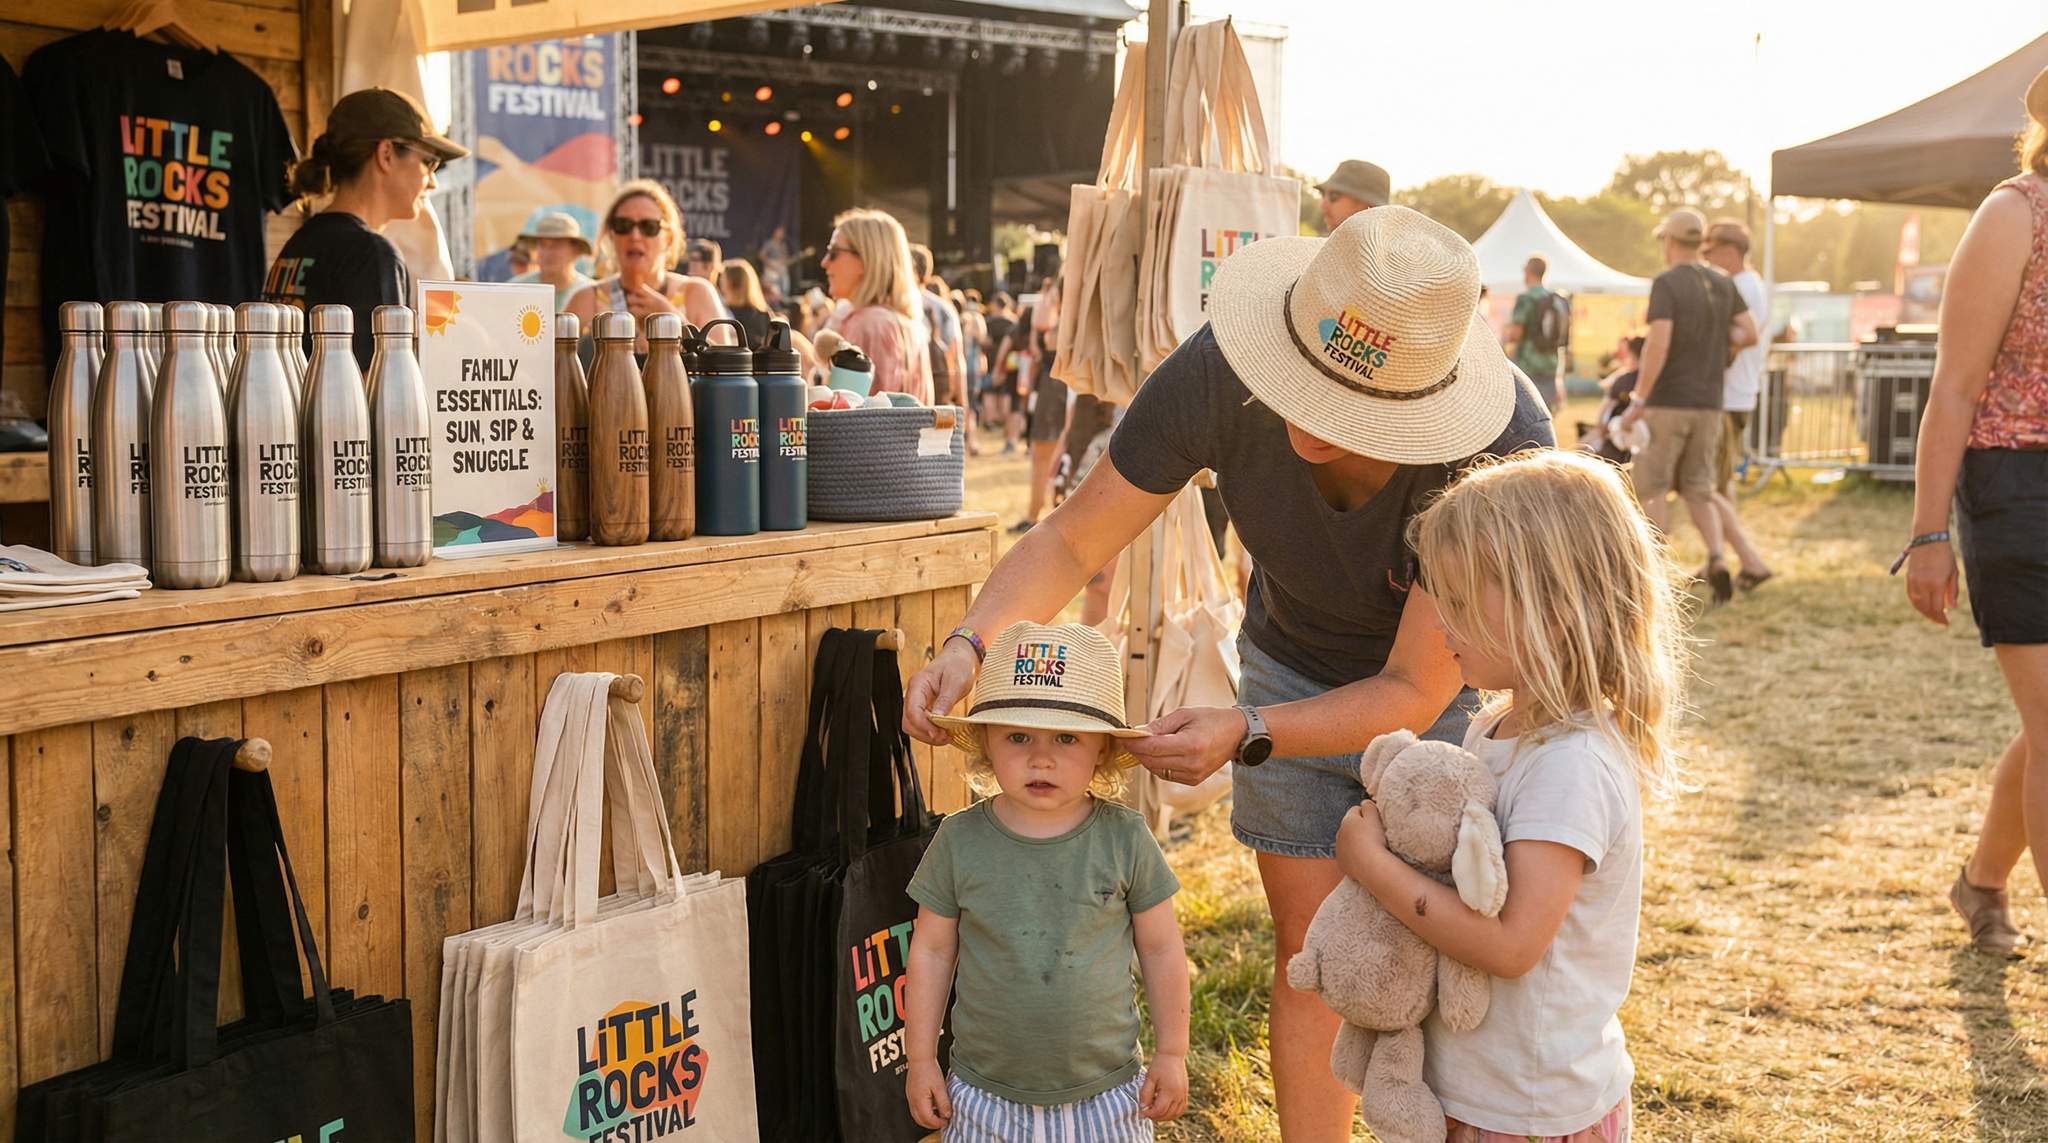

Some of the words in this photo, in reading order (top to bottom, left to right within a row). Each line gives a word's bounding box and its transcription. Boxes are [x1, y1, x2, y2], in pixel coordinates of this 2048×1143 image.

[487, 43, 605, 89] ROCKS
[488, 82, 606, 120] FESTIVAL
[639, 144, 730, 178] LITTLE
[123, 156, 231, 209] ROCKS
[664, 179, 731, 212] CKS
[127, 199, 227, 241] FESTIVAL
[1201, 228, 1276, 258] LITT
[1338, 310, 1398, 353] LITTLE
[1330, 325, 1387, 369] ROCKS
[461, 358, 520, 382] FAMILY
[1323, 342, 1374, 380] FESTIVAL
[436, 389, 542, 413] ESSENTIALS:
[446, 420, 485, 445] SUN,
[489, 418, 518, 442] SIP
[522, 417, 535, 441] &
[561, 427, 588, 441] LITT
[618, 430, 649, 445] LITTL
[666, 427, 695, 441] LITTL
[184, 446, 228, 464] LITTL
[259, 443, 299, 461] LITTL
[333, 440, 371, 458] LITTL
[395, 437, 431, 454] LITTL
[619, 445, 649, 461] ROC
[666, 442, 695, 457] ROC
[260, 462, 299, 481] ROCK
[396, 455, 432, 472] ROCK
[453, 448, 529, 474] SNUGGLE
[184, 465, 228, 484] ROCK
[1016, 643, 1067, 660] LITTLE
[1014, 658, 1066, 676] ROCKS
[1013, 674, 1063, 688] FESTIVAL
[856, 974, 908, 1043] ROC
[868, 1027, 909, 1074] FEST
[578, 1044, 701, 1132] ROCKS
